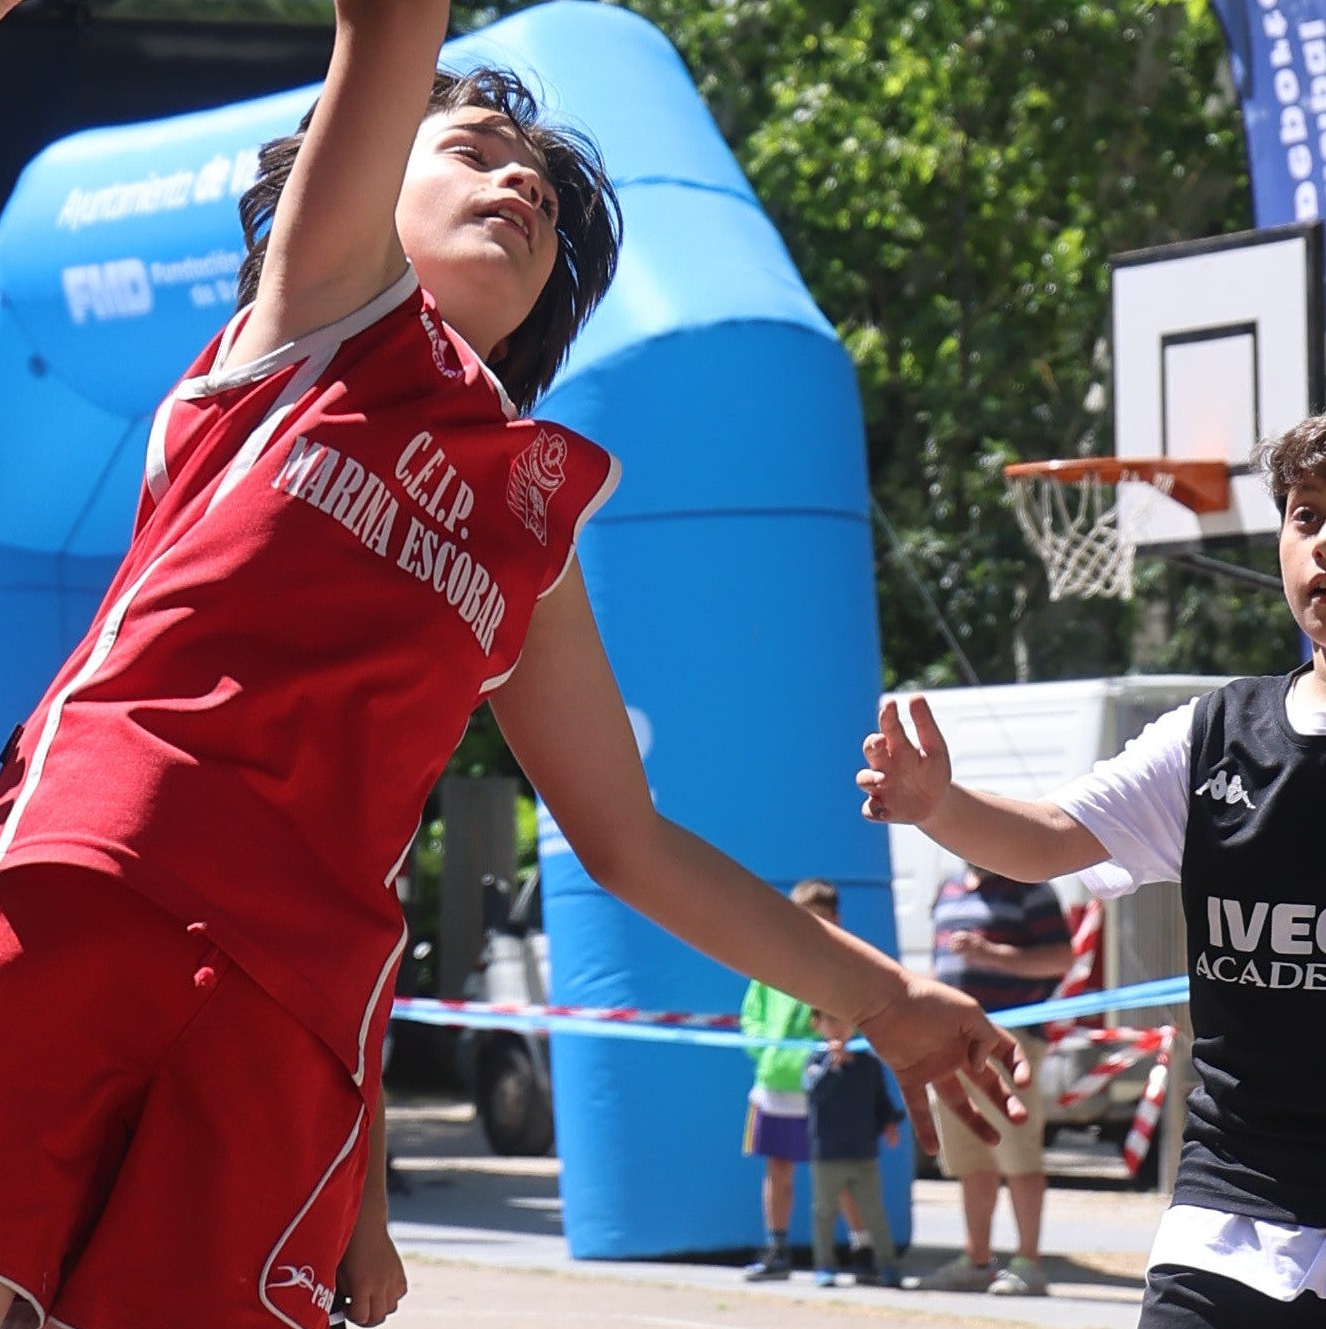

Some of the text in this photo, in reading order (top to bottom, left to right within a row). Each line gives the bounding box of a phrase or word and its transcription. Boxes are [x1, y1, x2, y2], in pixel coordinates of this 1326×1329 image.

[62, 257, 152, 324] FMD
[271, 435, 399, 557] MARINA
[395, 431, 474, 540] C.E.I.P.
[396, 517, 506, 657] ESCOBAR
[1207, 895, 1326, 955] IVE
